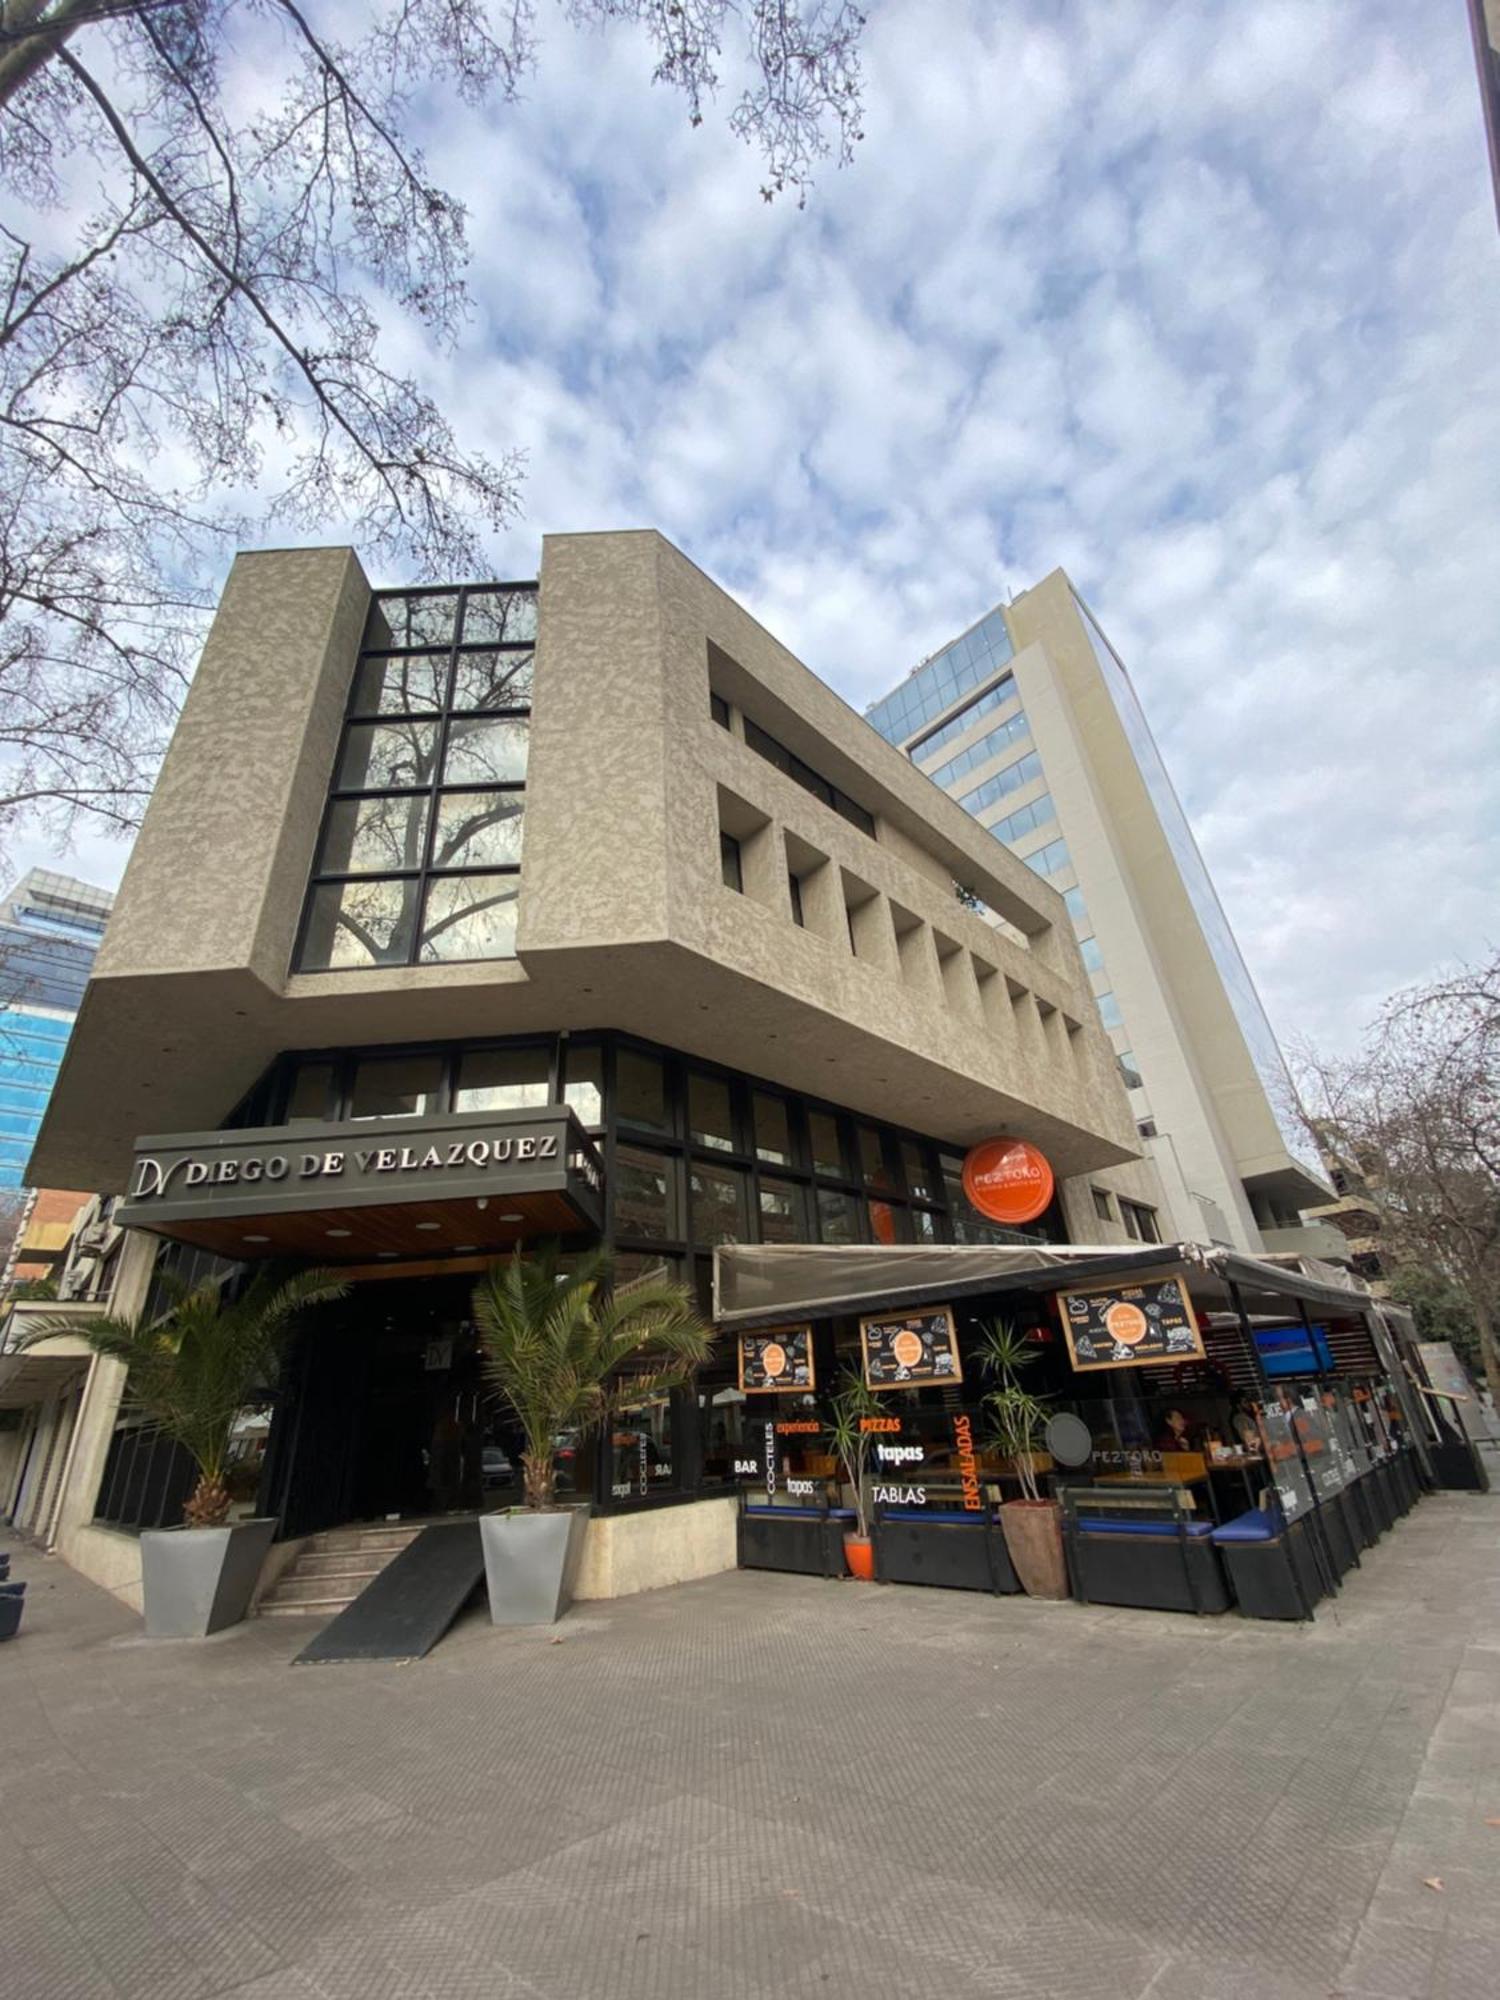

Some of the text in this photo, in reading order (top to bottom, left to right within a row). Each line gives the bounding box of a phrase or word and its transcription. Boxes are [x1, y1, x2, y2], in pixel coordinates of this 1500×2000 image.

[184, 1155, 288, 1185] DIEGO
[298, 1151, 345, 1177] DE
[355, 1135, 558, 1173] VELAZQUEZ
[860, 1418, 901, 1433] PIZZAS
[764, 1422, 776, 1495] COCTELES
[877, 1444, 924, 1466] tapas
[953, 1415, 981, 1511] ENSALADAS
[734, 1460, 758, 1474] BAR
[786, 1477, 814, 1498] tapas
[872, 1486, 926, 1505] TABLAS
